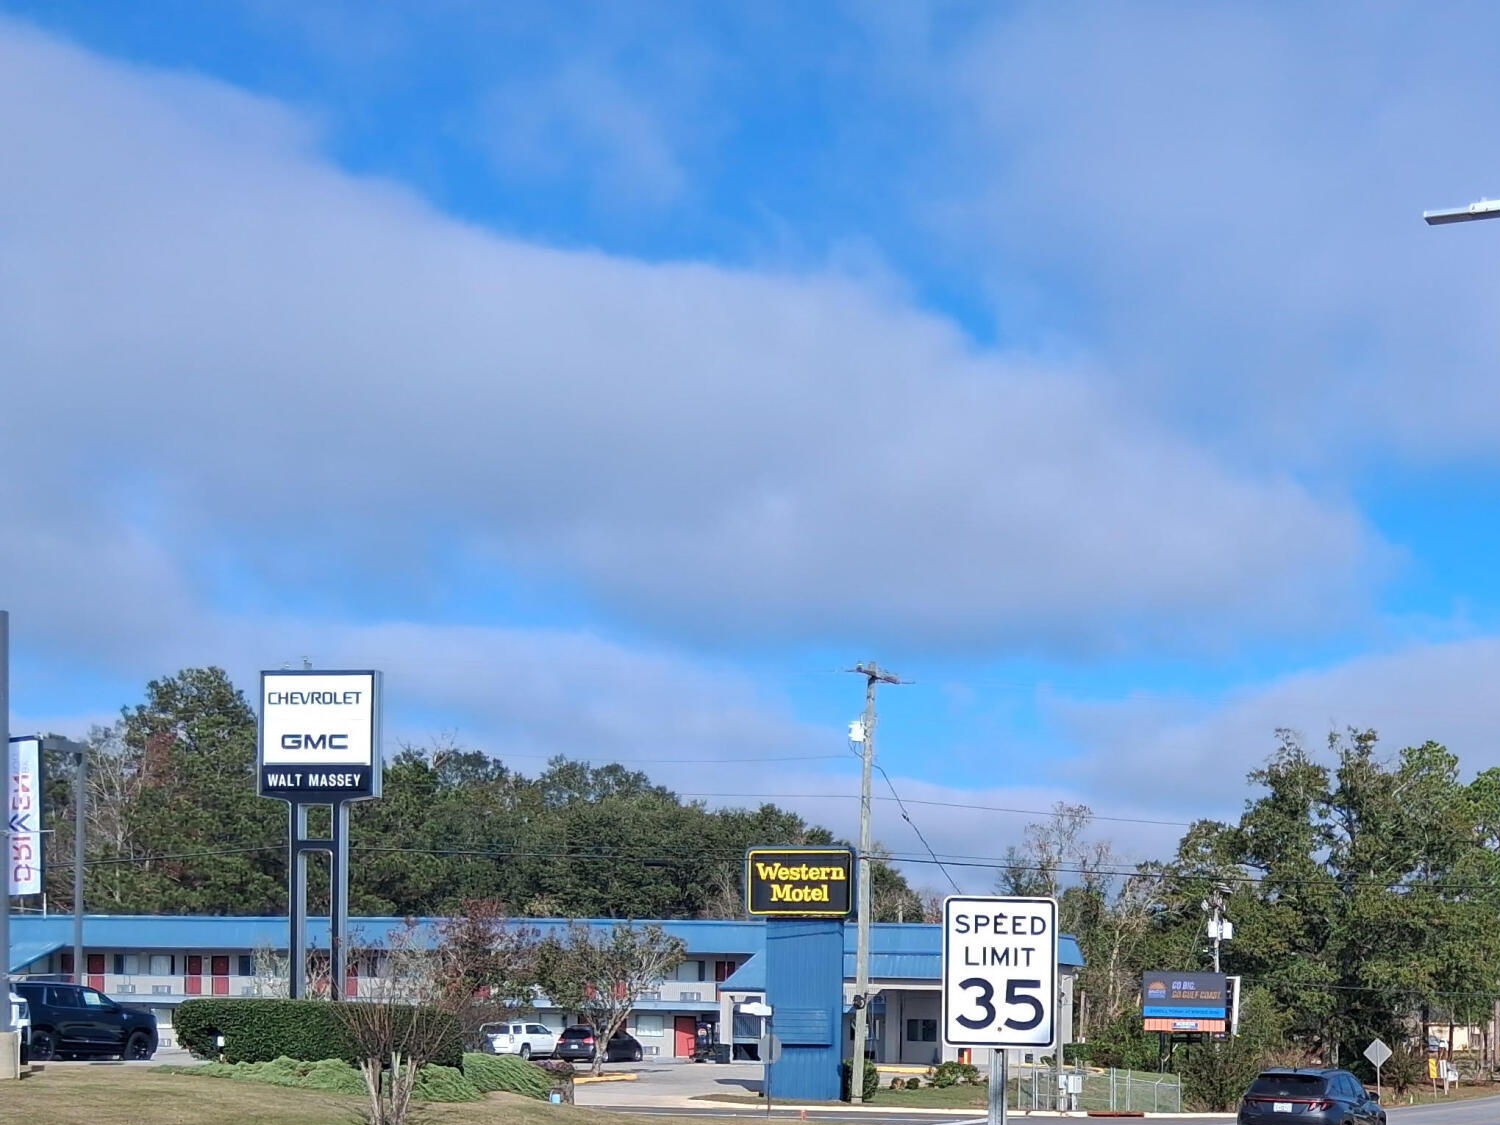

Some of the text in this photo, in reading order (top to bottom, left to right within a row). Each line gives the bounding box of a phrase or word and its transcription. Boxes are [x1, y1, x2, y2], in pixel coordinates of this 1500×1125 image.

[268, 691, 362, 705] CHEVROLET
[281, 734, 348, 750] GMC
[267, 773, 361, 787] WALT MASSEY
[755, 862, 846, 881] Western
[770, 883, 830, 902] Motel
[954, 913, 1047, 936] SPEED
[964, 946, 1036, 967] LIMIT
[955, 977, 1045, 1031] 35
[1182, 991, 1199, 1000] GULF
